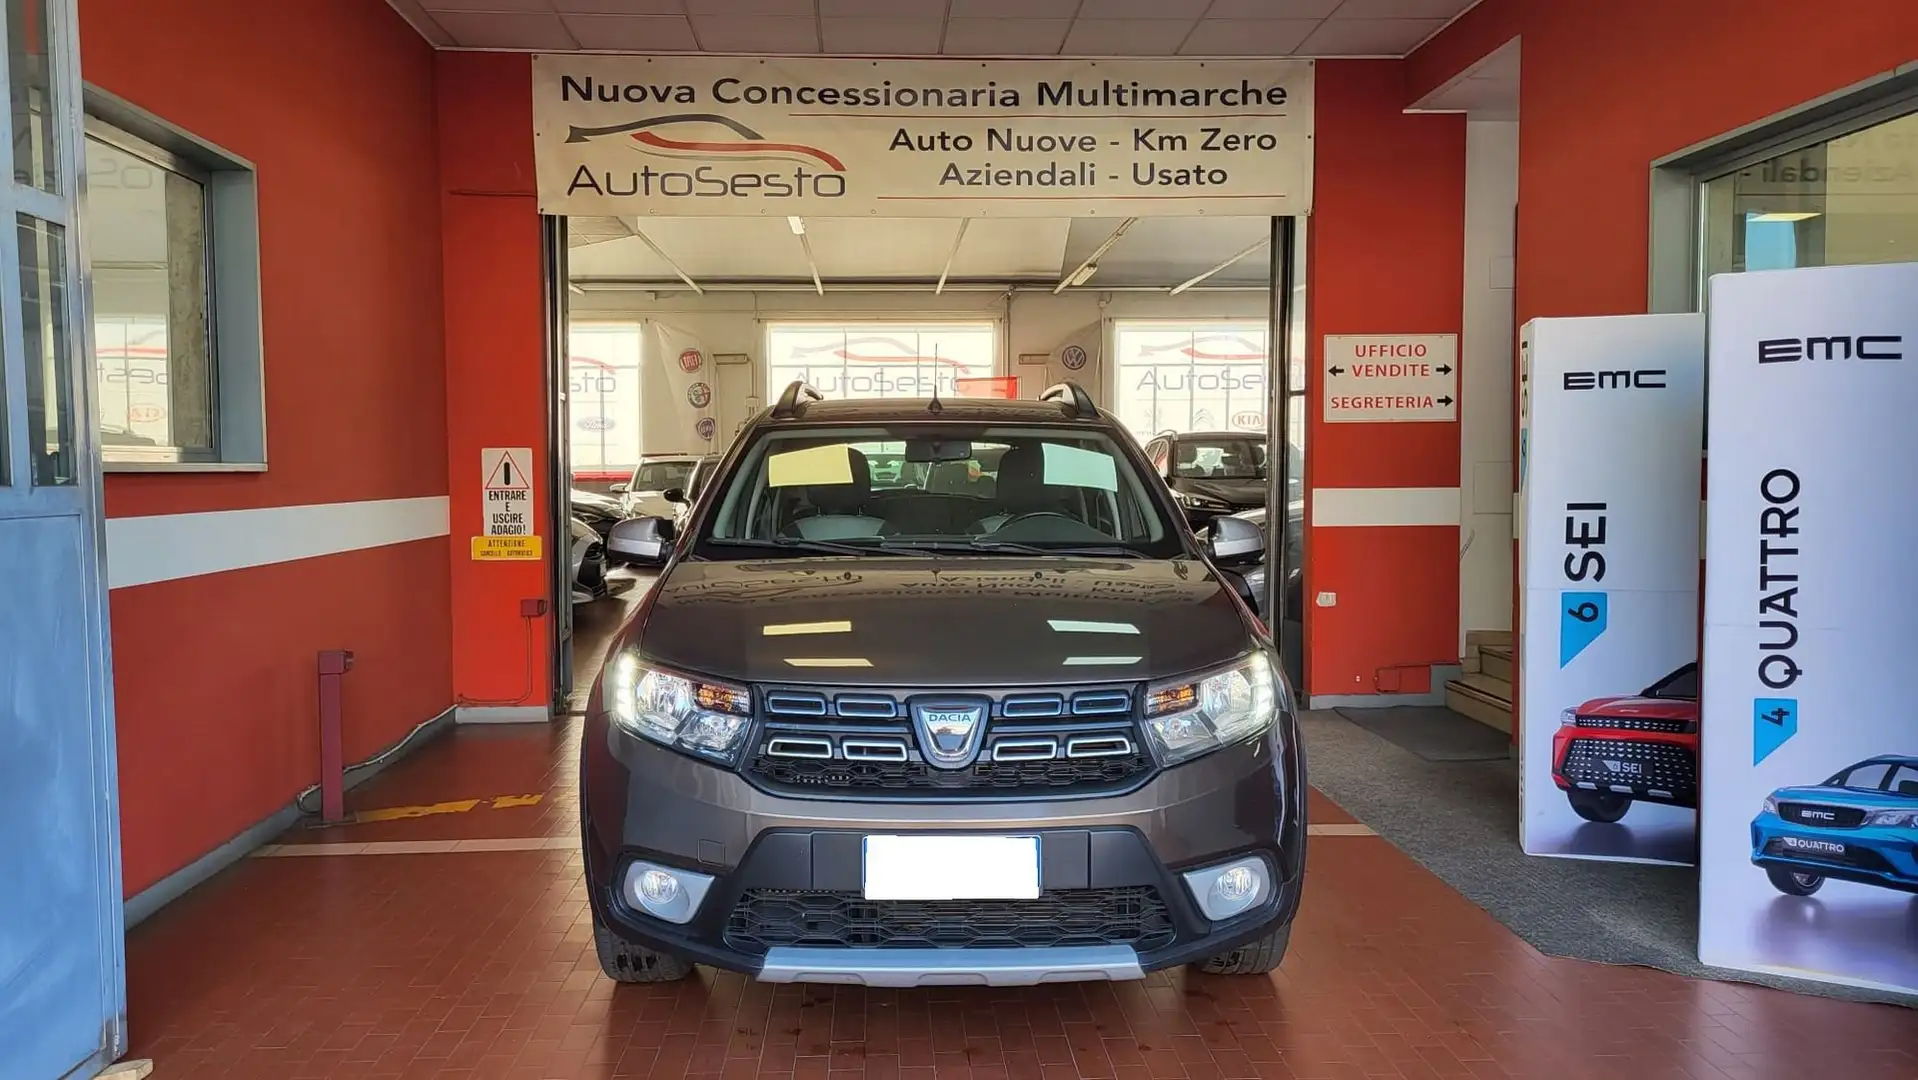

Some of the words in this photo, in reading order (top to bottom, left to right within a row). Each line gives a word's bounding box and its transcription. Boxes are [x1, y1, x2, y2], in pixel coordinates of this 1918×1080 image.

[561, 75, 695, 103] Nuova
[712, 78, 1020, 107] Concessionaria
[1037, 79, 1288, 108] Multimarche
[889, 127, 973, 152] Auto
[986, 127, 1097, 152] Nuove
[1132, 127, 1188, 152] Km
[1200, 127, 1278, 152] Zero
[567, 164, 846, 198] AutoSesto
[938, 161, 1096, 187] Aziendali
[1132, 162, 1228, 187] Usato
[1355, 344, 1427, 358] UFFICIO
[1352, 364, 1430, 377] VENDITE
[1331, 396, 1434, 409] SEGRETERIA
[488, 490, 527, 501] ENTRARE
[505, 501, 511, 512] E
[493, 513, 523, 524] USCIRE
[491, 525, 526, 535] ADAGIO!
[1563, 502, 1607, 583] SEI
[1758, 468, 1803, 690] QUATTRO
[1567, 601, 1599, 623] 6
[929, 714, 971, 722] DACIA
[1761, 707, 1790, 726] 4
[1622, 762, 1642, 774] SEI
[1797, 839, 1845, 853] QUATTRO
